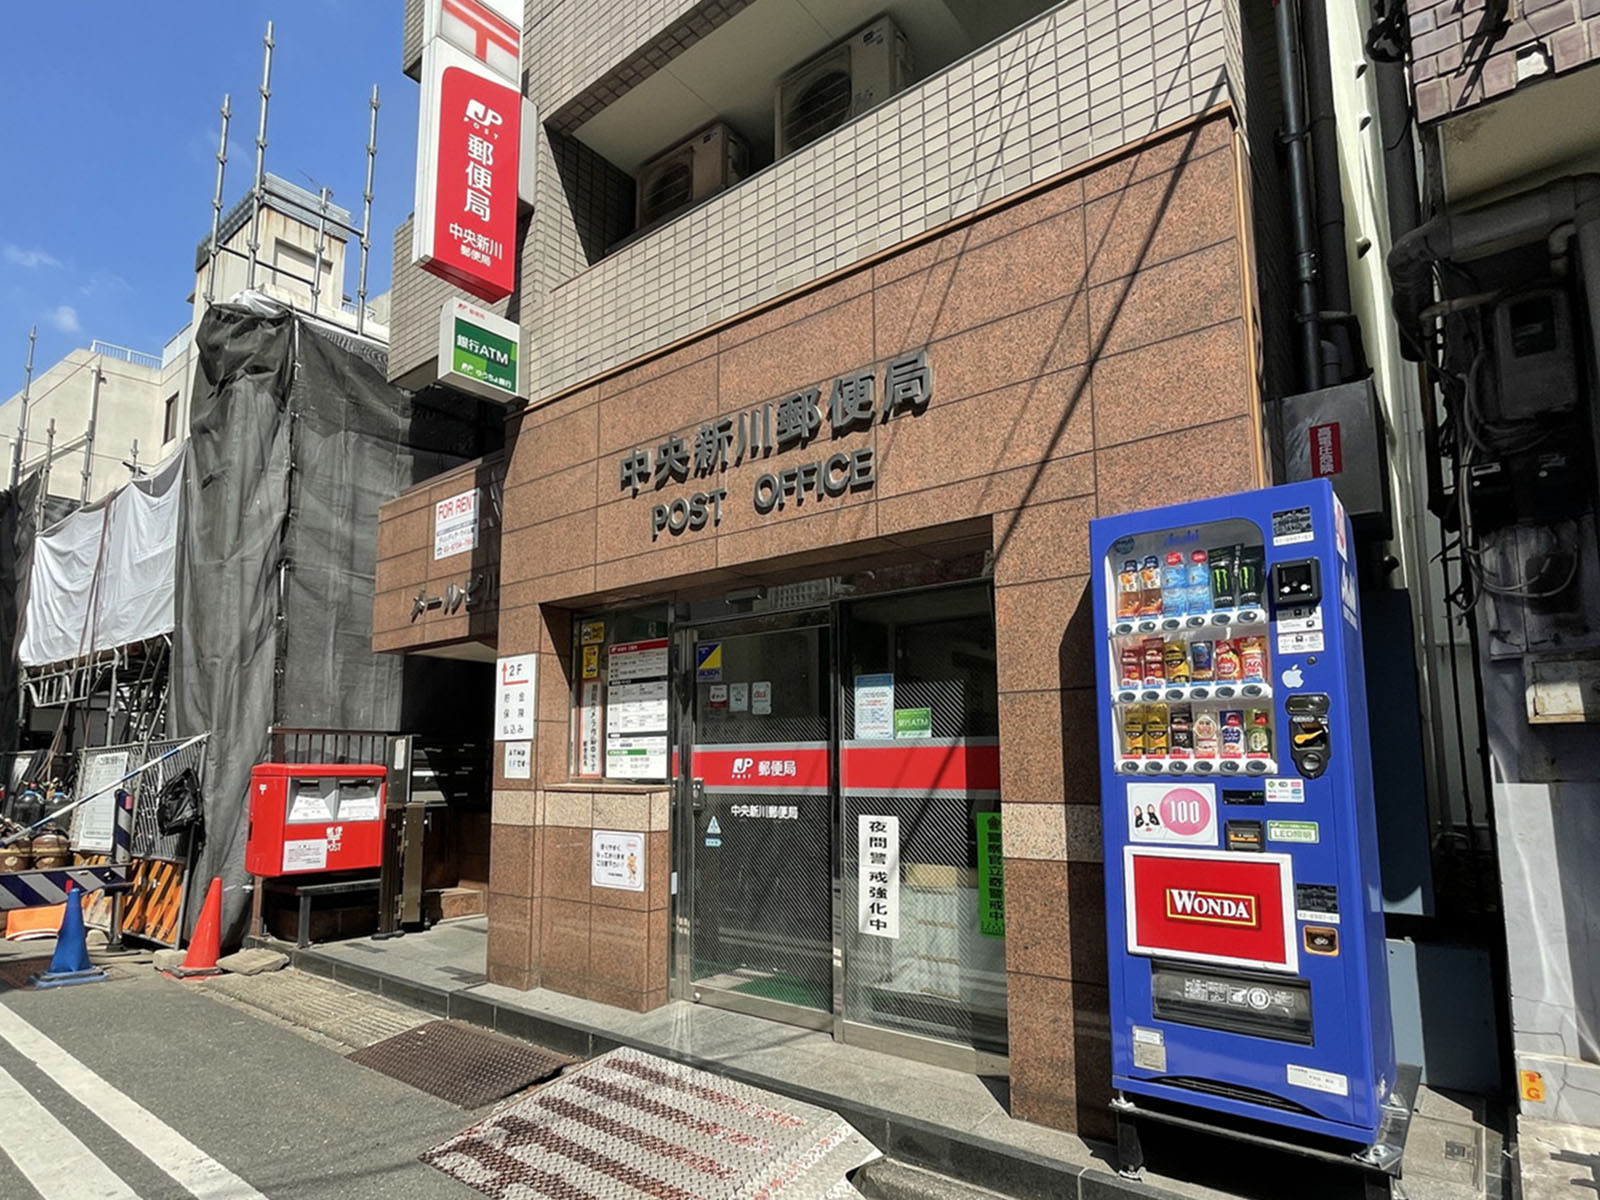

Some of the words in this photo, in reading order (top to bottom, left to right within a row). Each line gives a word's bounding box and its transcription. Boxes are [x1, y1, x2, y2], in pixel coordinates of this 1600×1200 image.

[465, 98, 503, 127] JP
[464, 133, 494, 223] 郵便局
[449, 222, 503, 260] 中央新川
[460, 244, 492, 267] 郵便局
[456, 334, 509, 365] 銀行ATM
[619, 350, 931, 499] 中央新川郵便局
[652, 488, 727, 542] POST
[754, 446, 875, 516] OFFICE
[438, 501, 454, 520] FOR
[509, 663, 523, 677] 2F
[732, 757, 754, 774] JP
[758, 760, 797, 777] 郵便局
[730, 803, 799, 820] 中央新川郵便局
[1170, 800, 1201, 824] 100
[867, 820, 888, 931] 夜間警戒強化中
[1170, 889, 1250, 919] WONDA
[1527, 1088, 1541, 1100] G
